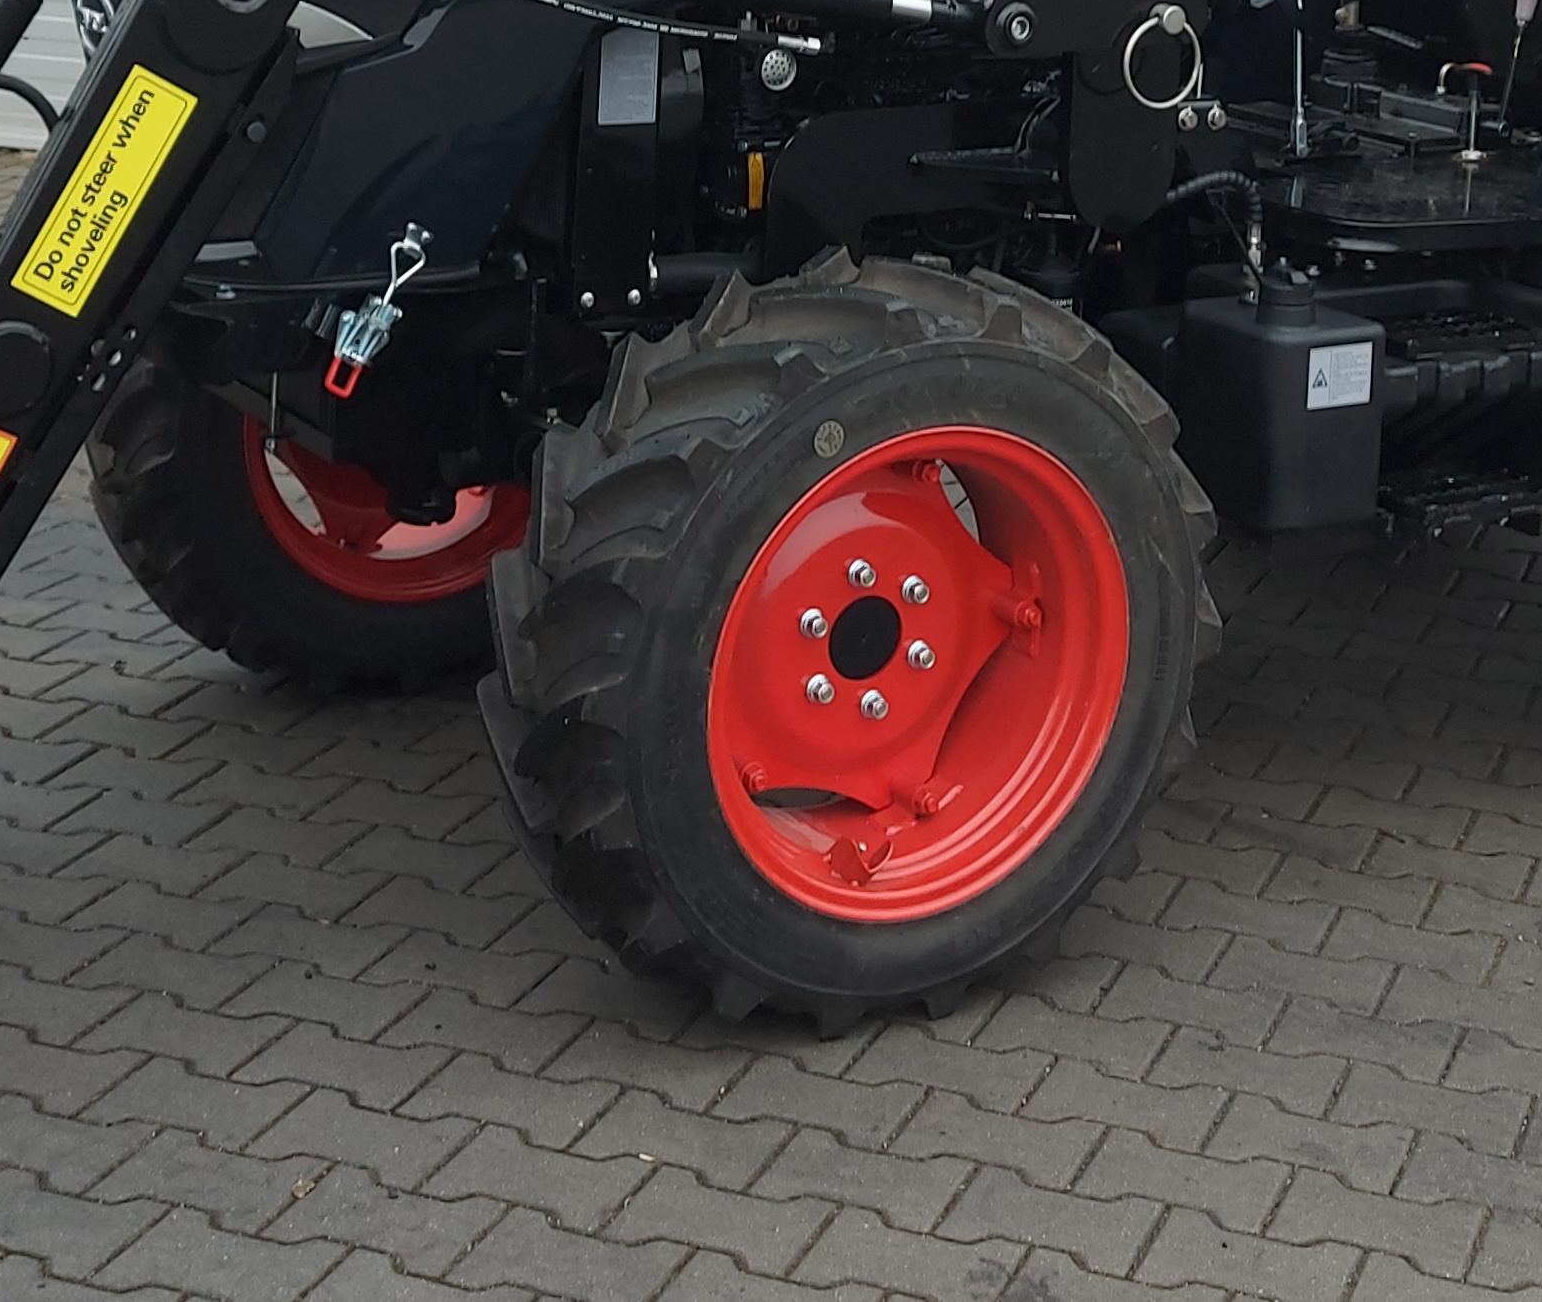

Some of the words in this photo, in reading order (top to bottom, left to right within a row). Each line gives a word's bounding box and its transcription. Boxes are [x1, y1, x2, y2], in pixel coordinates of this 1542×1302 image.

[33, 250, 62, 282] Do
[58, 208, 87, 247] not
[81, 150, 118, 206] steer
[112, 90, 155, 148] when
[60, 190, 128, 293] shoveling
